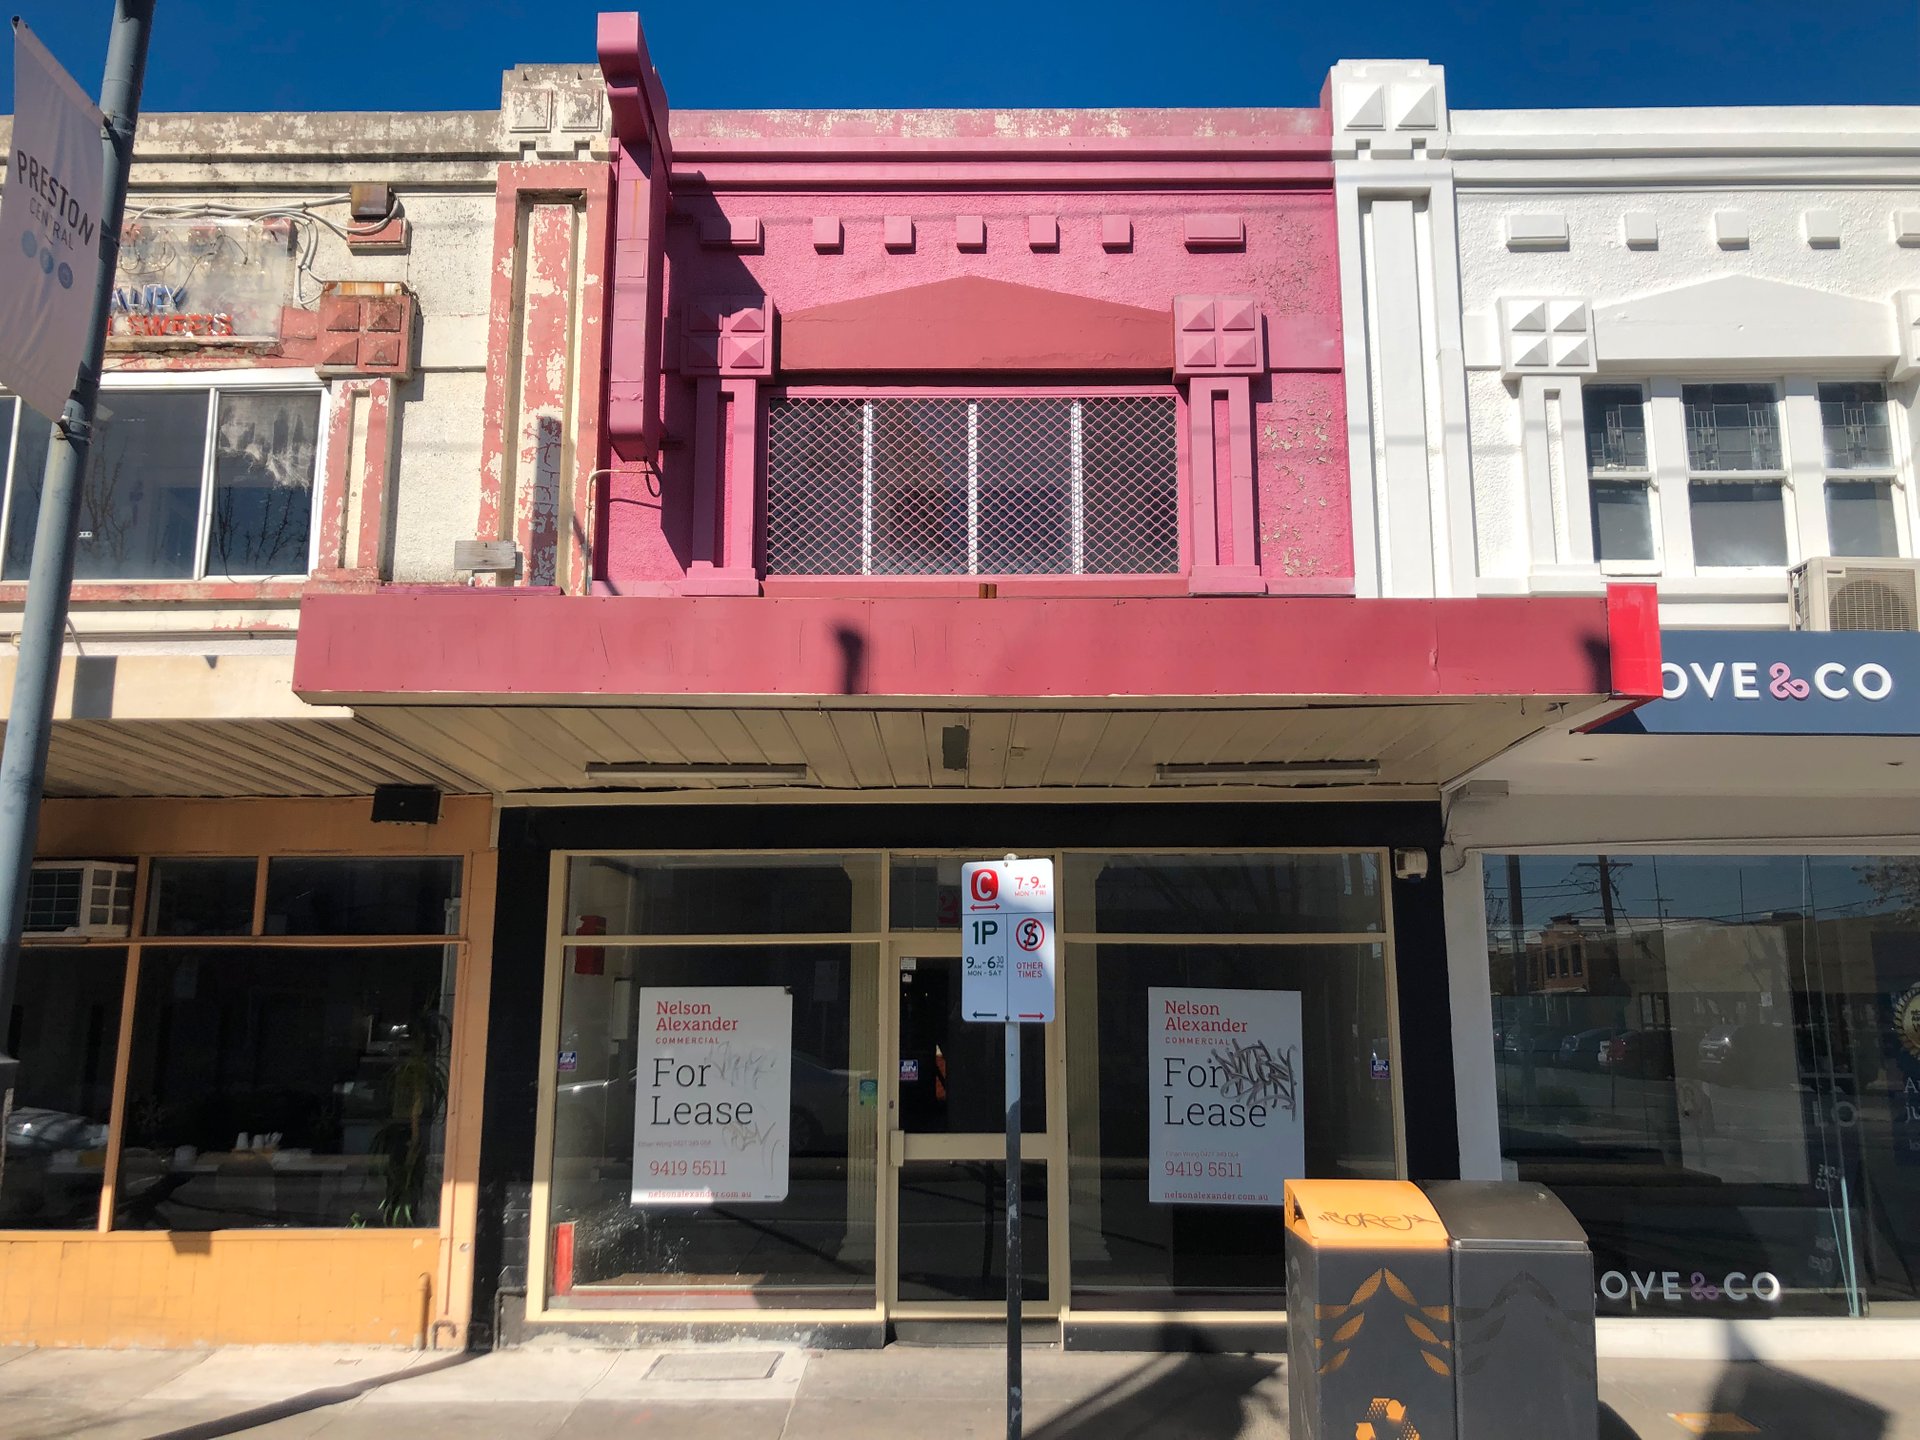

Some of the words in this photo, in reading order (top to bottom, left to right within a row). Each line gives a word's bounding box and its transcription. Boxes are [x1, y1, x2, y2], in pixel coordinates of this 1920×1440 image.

[17, 150, 94, 246] PRESTON
[29, 197, 74, 250] CENRAL
[1661, 662, 1760, 700] OVE
[1814, 662, 1893, 700] CO
[972, 920, 998, 945] 1P
[1016, 961, 1043, 970] OTHER
[1018, 970, 1043, 978] TIMES
[656, 1000, 711, 1015] Nelson
[1164, 1000, 1220, 1016] Nelson
[656, 1016, 739, 1031] Alexander
[1164, 1016, 1248, 1033] Alexander
[655, 1036, 720, 1045] COMMERCIAL
[1165, 1036, 1230, 1046] COMMERCIAL
[652, 1057, 712, 1087] For
[1163, 1057, 1223, 1088] For
[650, 1095, 753, 1126] Lease
[1164, 1095, 1267, 1127] Lease
[650, 1160, 688, 1176] 9419
[692, 1160, 727, 1176] 5511
[1165, 1160, 1203, 1177] 9419
[1208, 1161, 1243, 1178] 5511
[1599, 1270, 1682, 1300] OVE
[1723, 1271, 1781, 1301] CO
